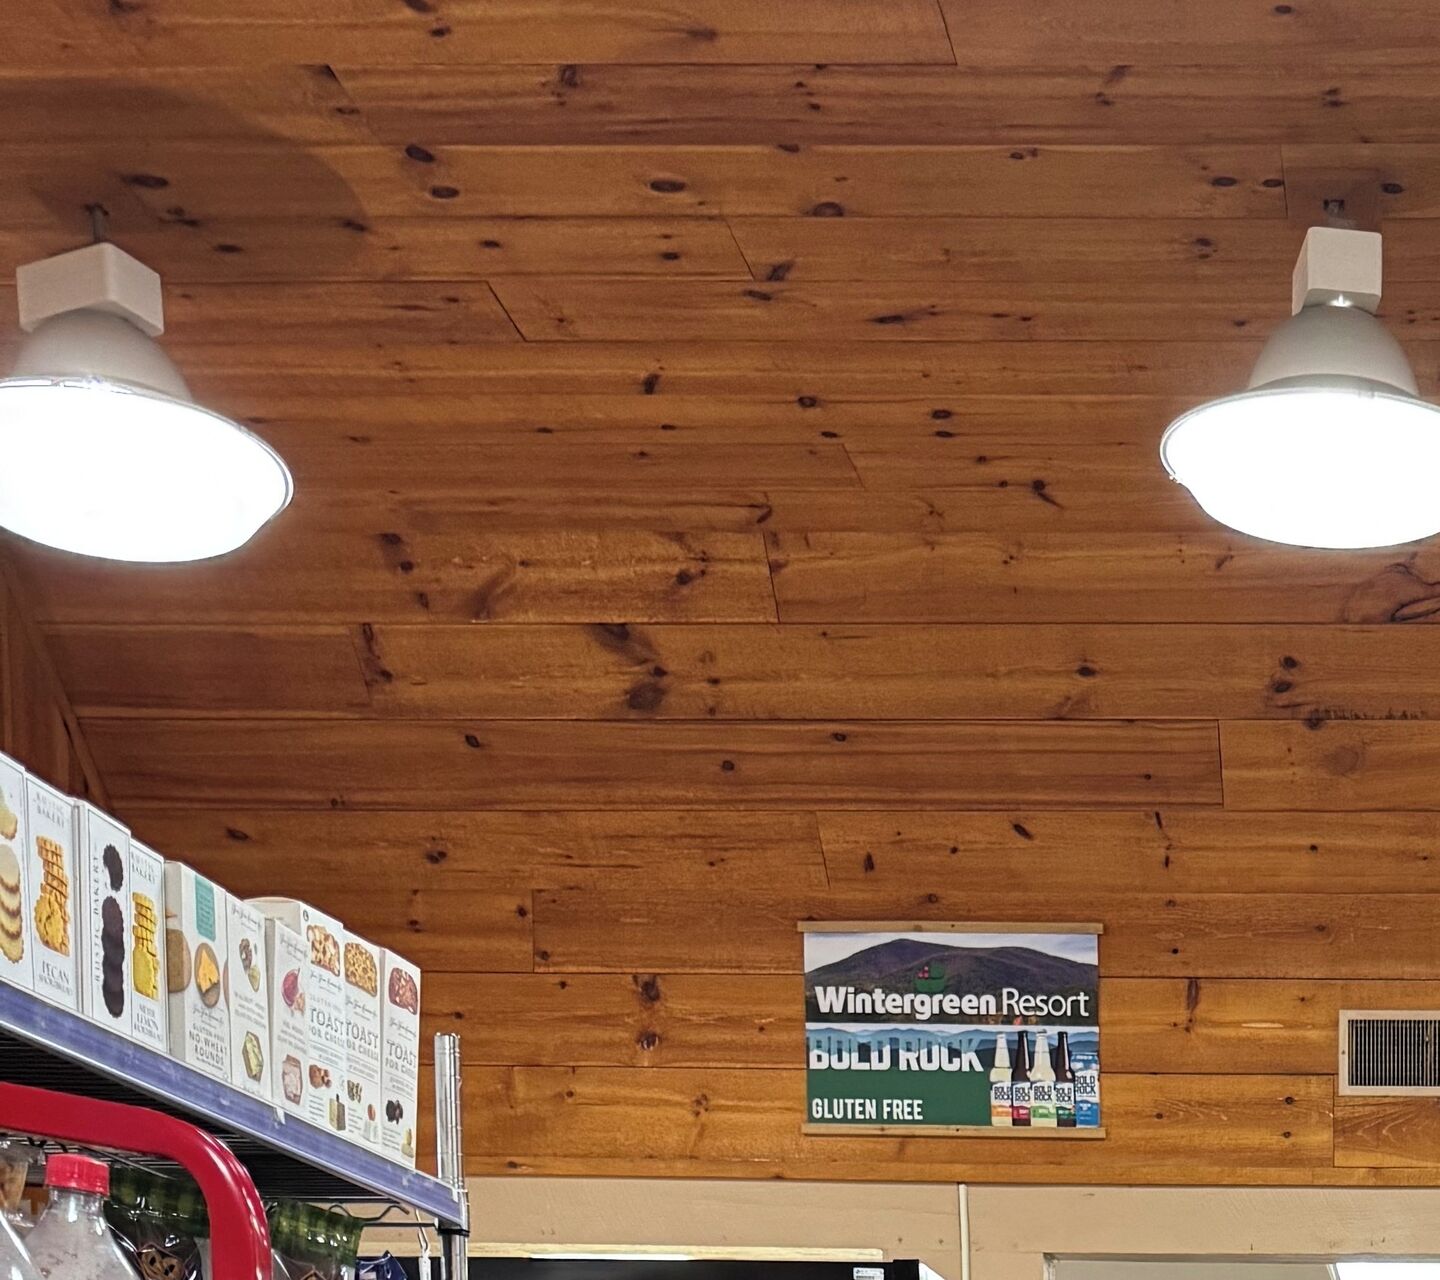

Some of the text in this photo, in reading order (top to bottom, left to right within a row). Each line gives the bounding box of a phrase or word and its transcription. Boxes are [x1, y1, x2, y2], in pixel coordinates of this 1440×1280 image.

[815, 985, 1089, 1020] Wintergreen Resort
[809, 1036, 984, 1072] BOLD ROCK
[812, 1098, 923, 1120] GLUTEN FREE
